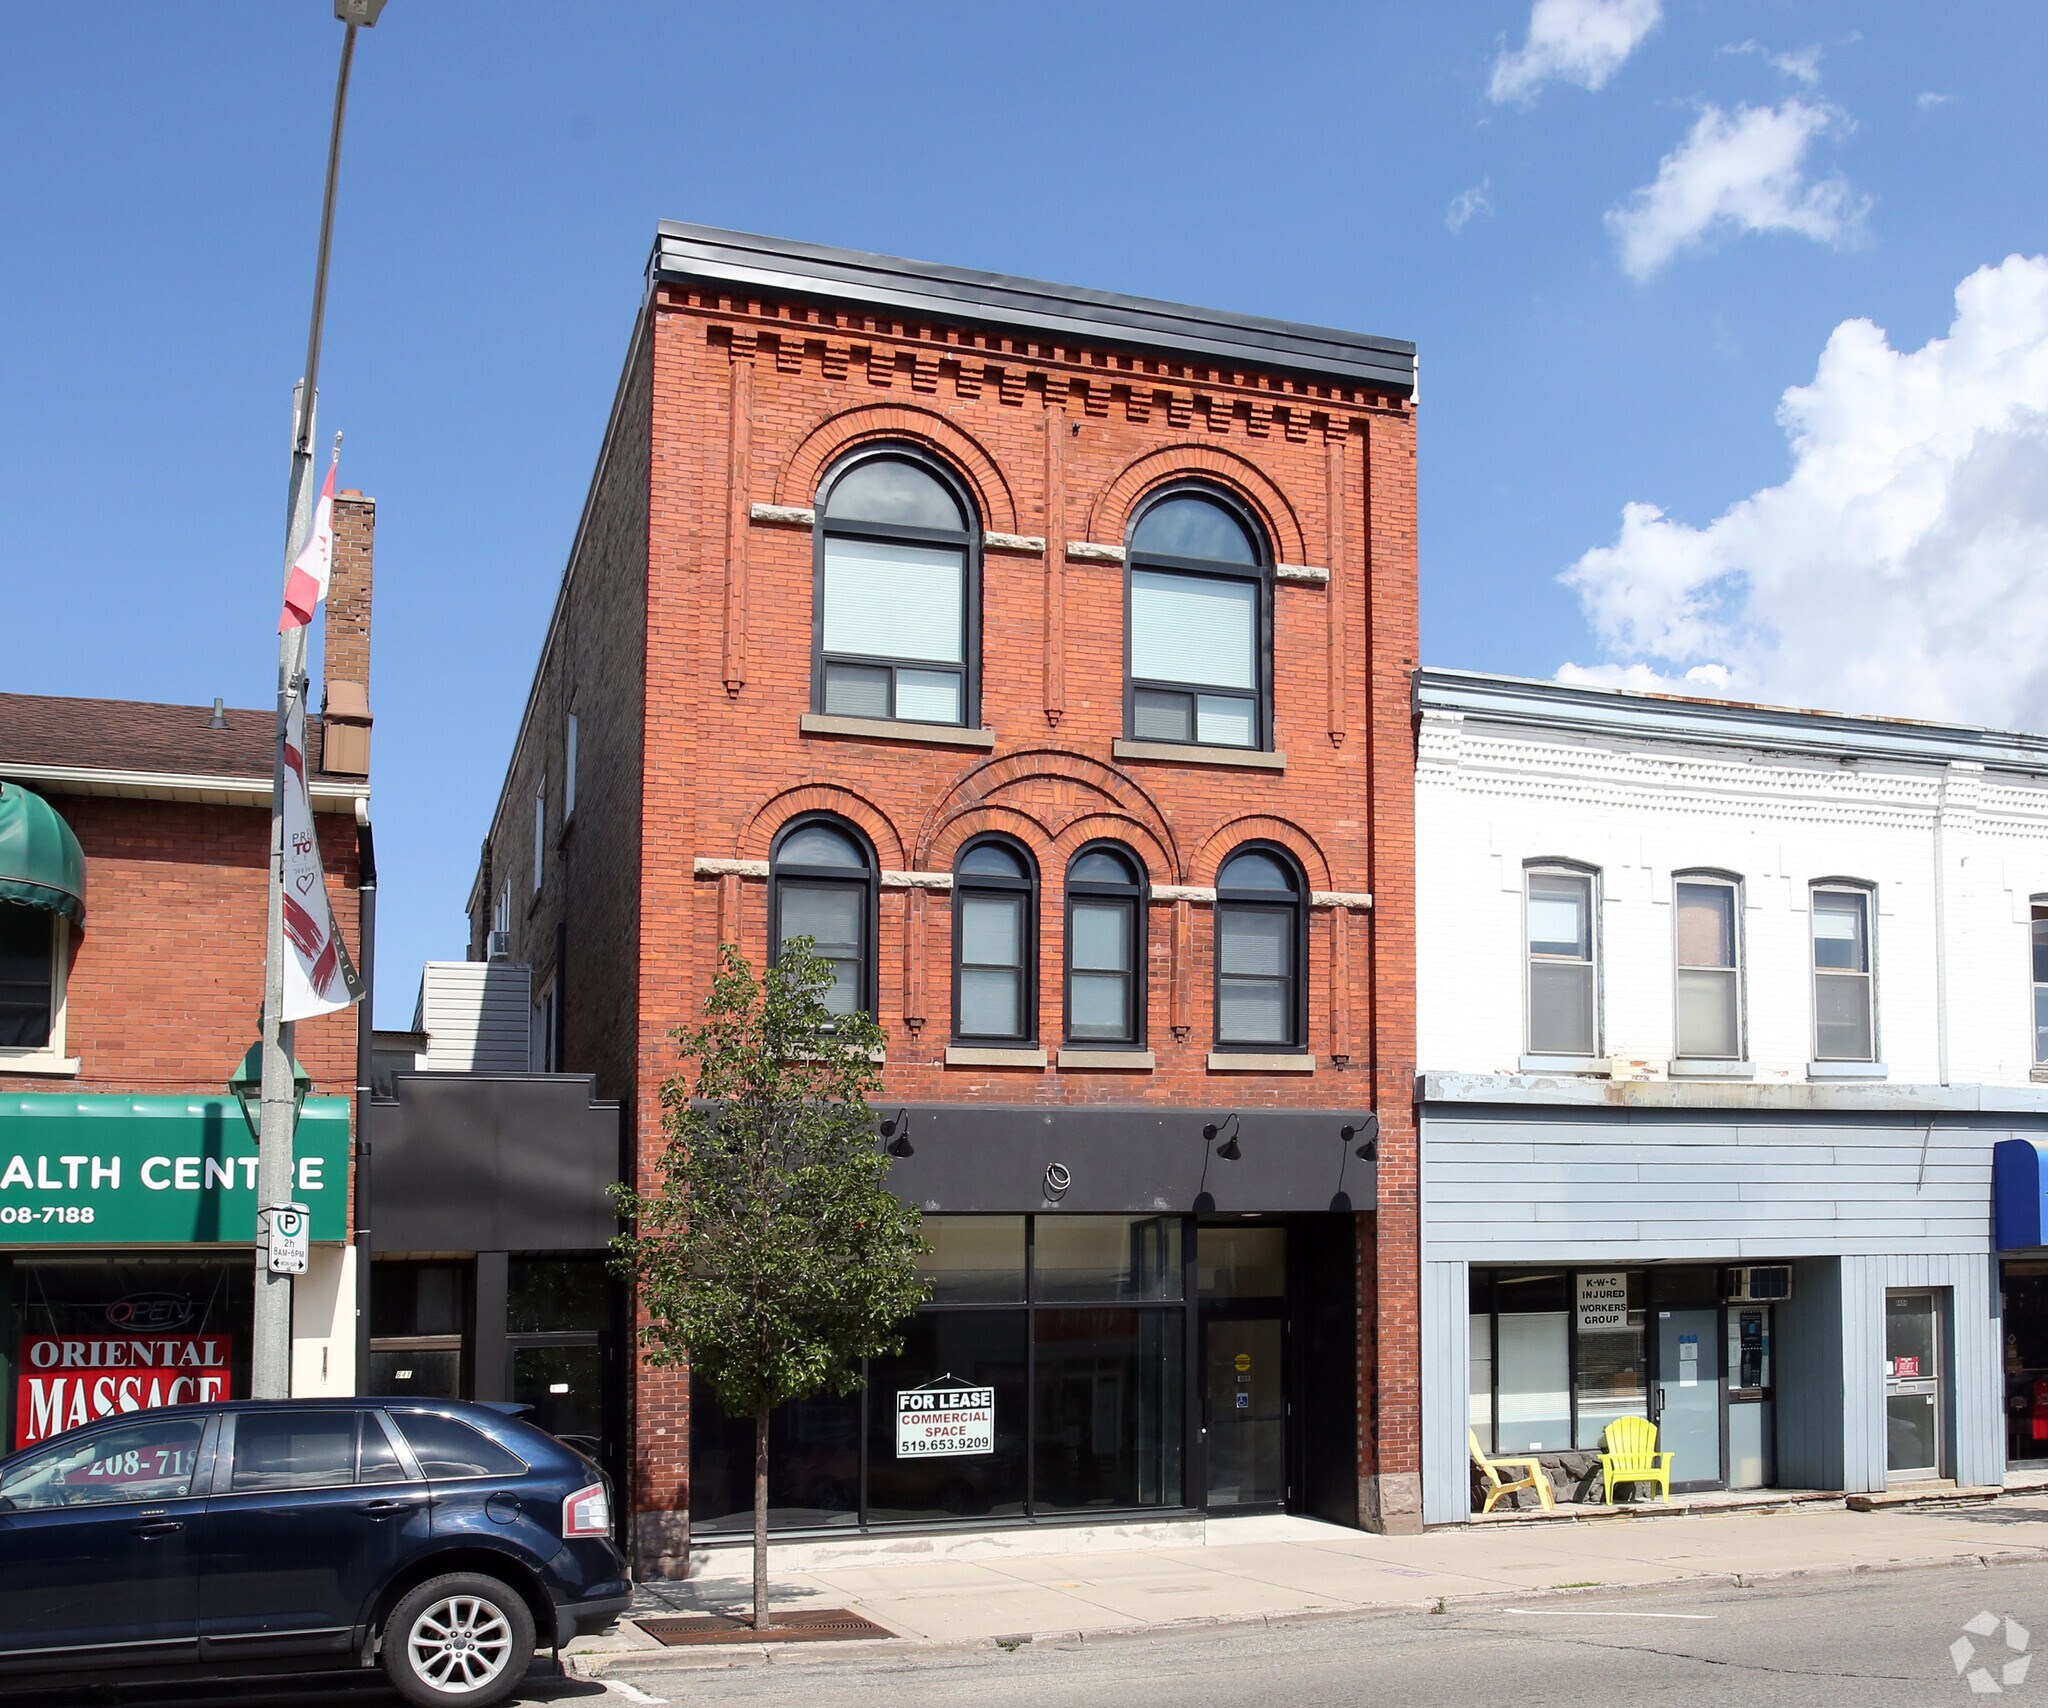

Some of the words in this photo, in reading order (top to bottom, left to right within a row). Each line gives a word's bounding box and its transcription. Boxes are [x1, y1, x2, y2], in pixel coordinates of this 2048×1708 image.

[0, 1155, 121, 1190] ALTH
[140, 1156, 325, 1190] CENTE
[0, 1206, 95, 1224] 08-7188
[285, 1214, 296, 1229] P
[284, 1239, 295, 1248] 2h
[1586, 1278, 1617, 1287] K-W-C
[1582, 1290, 1625, 1299] INJURED
[110, 1301, 192, 1321] OPEN
[1580, 1303, 1627, 1312] WORKERS
[1584, 1315, 1619, 1324] GROUP
[30, 1341, 225, 1368] ORIENTAL
[900, 1394, 935, 1410] FOR
[939, 1392, 991, 1409] LEASE
[902, 1411, 989, 1425] COMMERCIAL
[925, 1426, 967, 1437] SPACE
[902, 1437, 989, 1451] 519.653.9209
